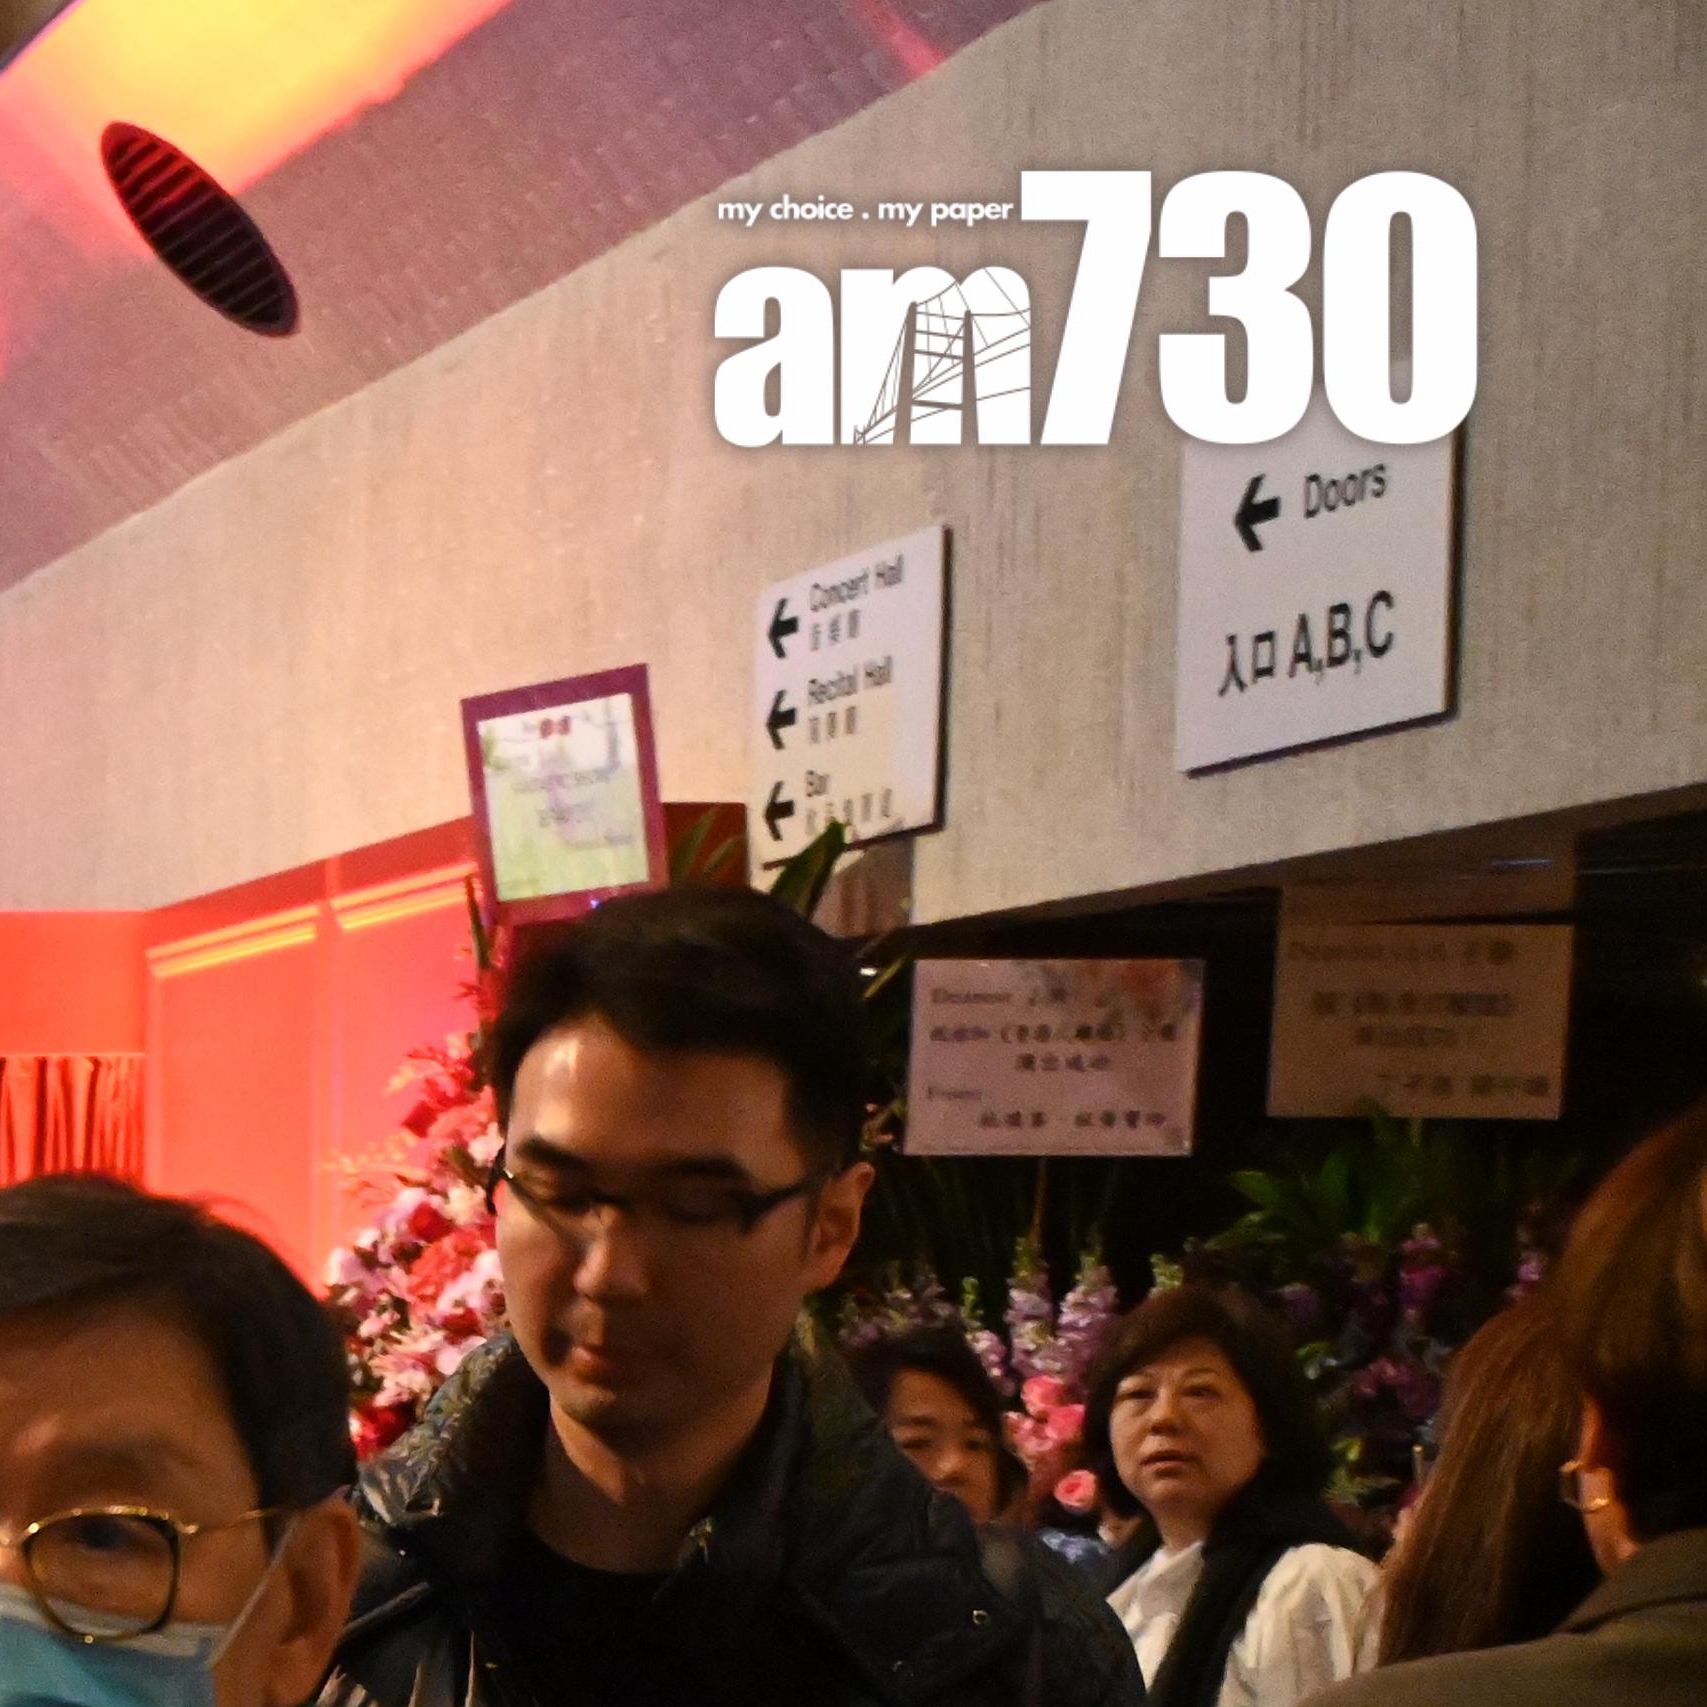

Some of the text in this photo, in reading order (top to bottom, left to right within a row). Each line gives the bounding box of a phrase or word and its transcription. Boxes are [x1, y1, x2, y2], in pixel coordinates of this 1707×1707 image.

[1304, 463, 1387, 519] Doors
[1218, 590, 1395, 697] 入口 A,B,C
